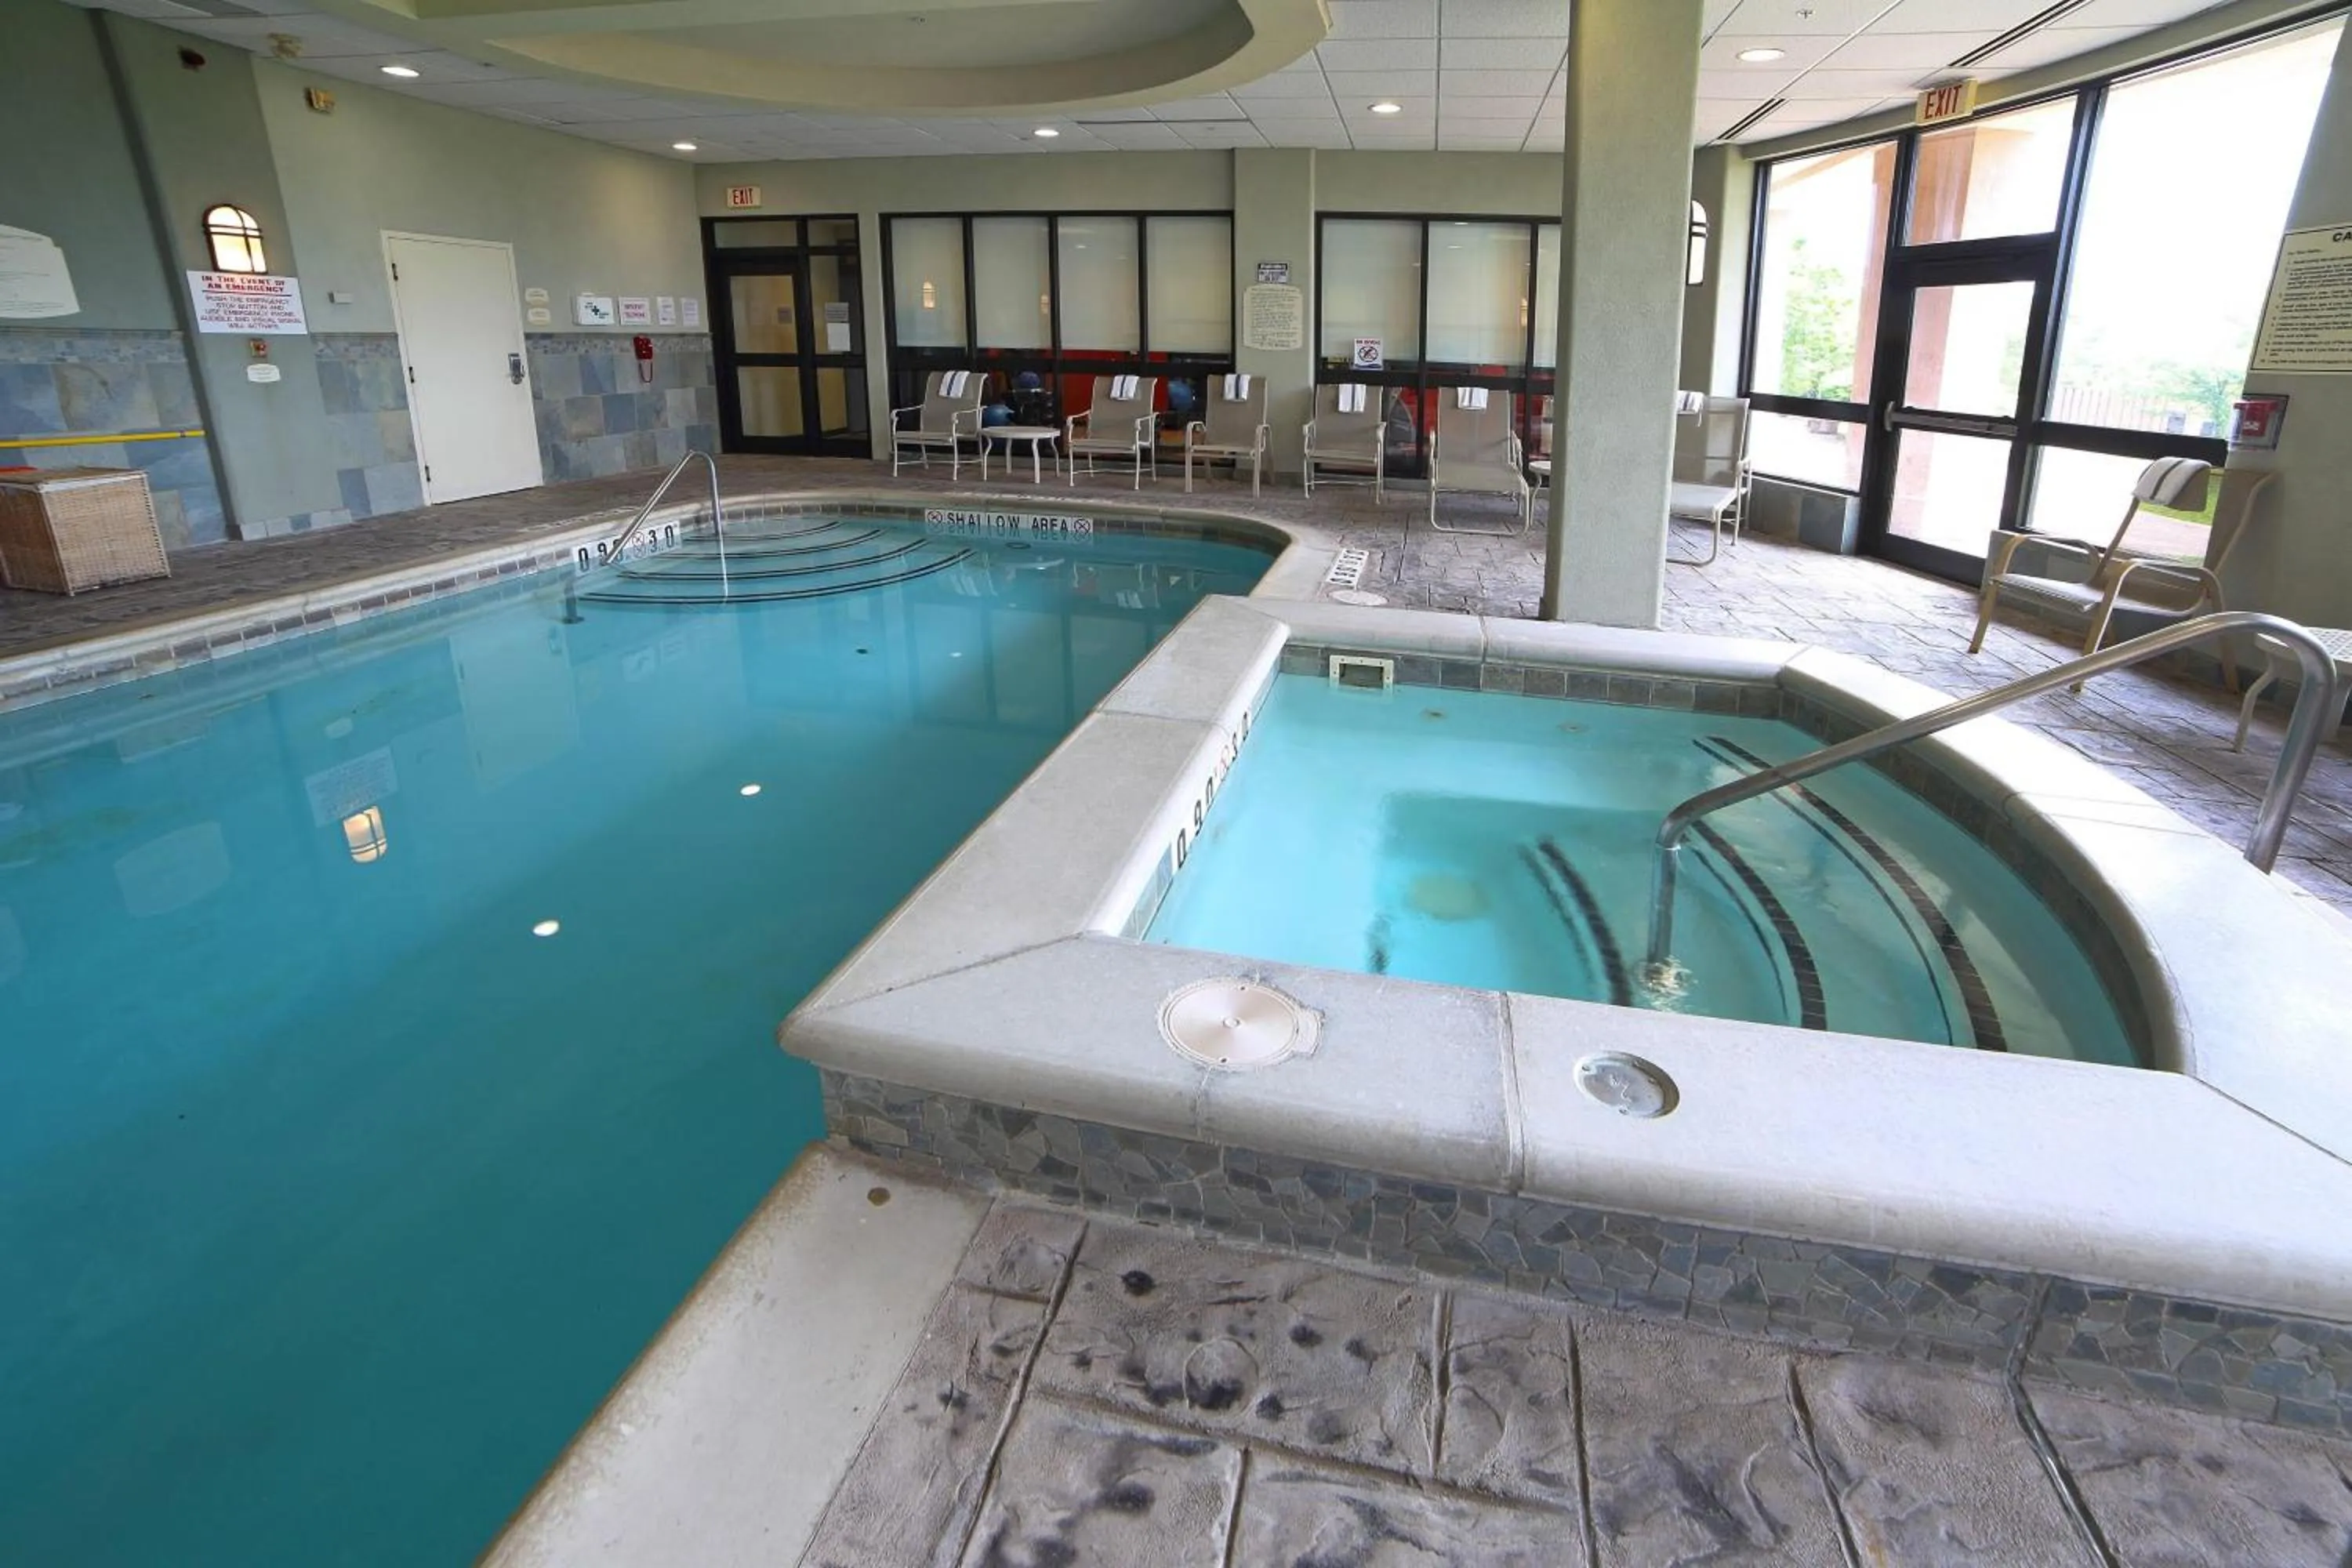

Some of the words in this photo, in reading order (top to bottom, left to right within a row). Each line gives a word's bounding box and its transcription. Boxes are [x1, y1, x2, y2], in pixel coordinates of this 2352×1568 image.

[1923, 84, 1962, 119] EXIT
[732, 187, 753, 205] EXIT
[225, 283, 285, 292] EMERGENCY
[240, 277, 271, 285] EVENT
[946, 511, 1020, 530] SHALLOW
[1031, 516, 1069, 533] AREA
